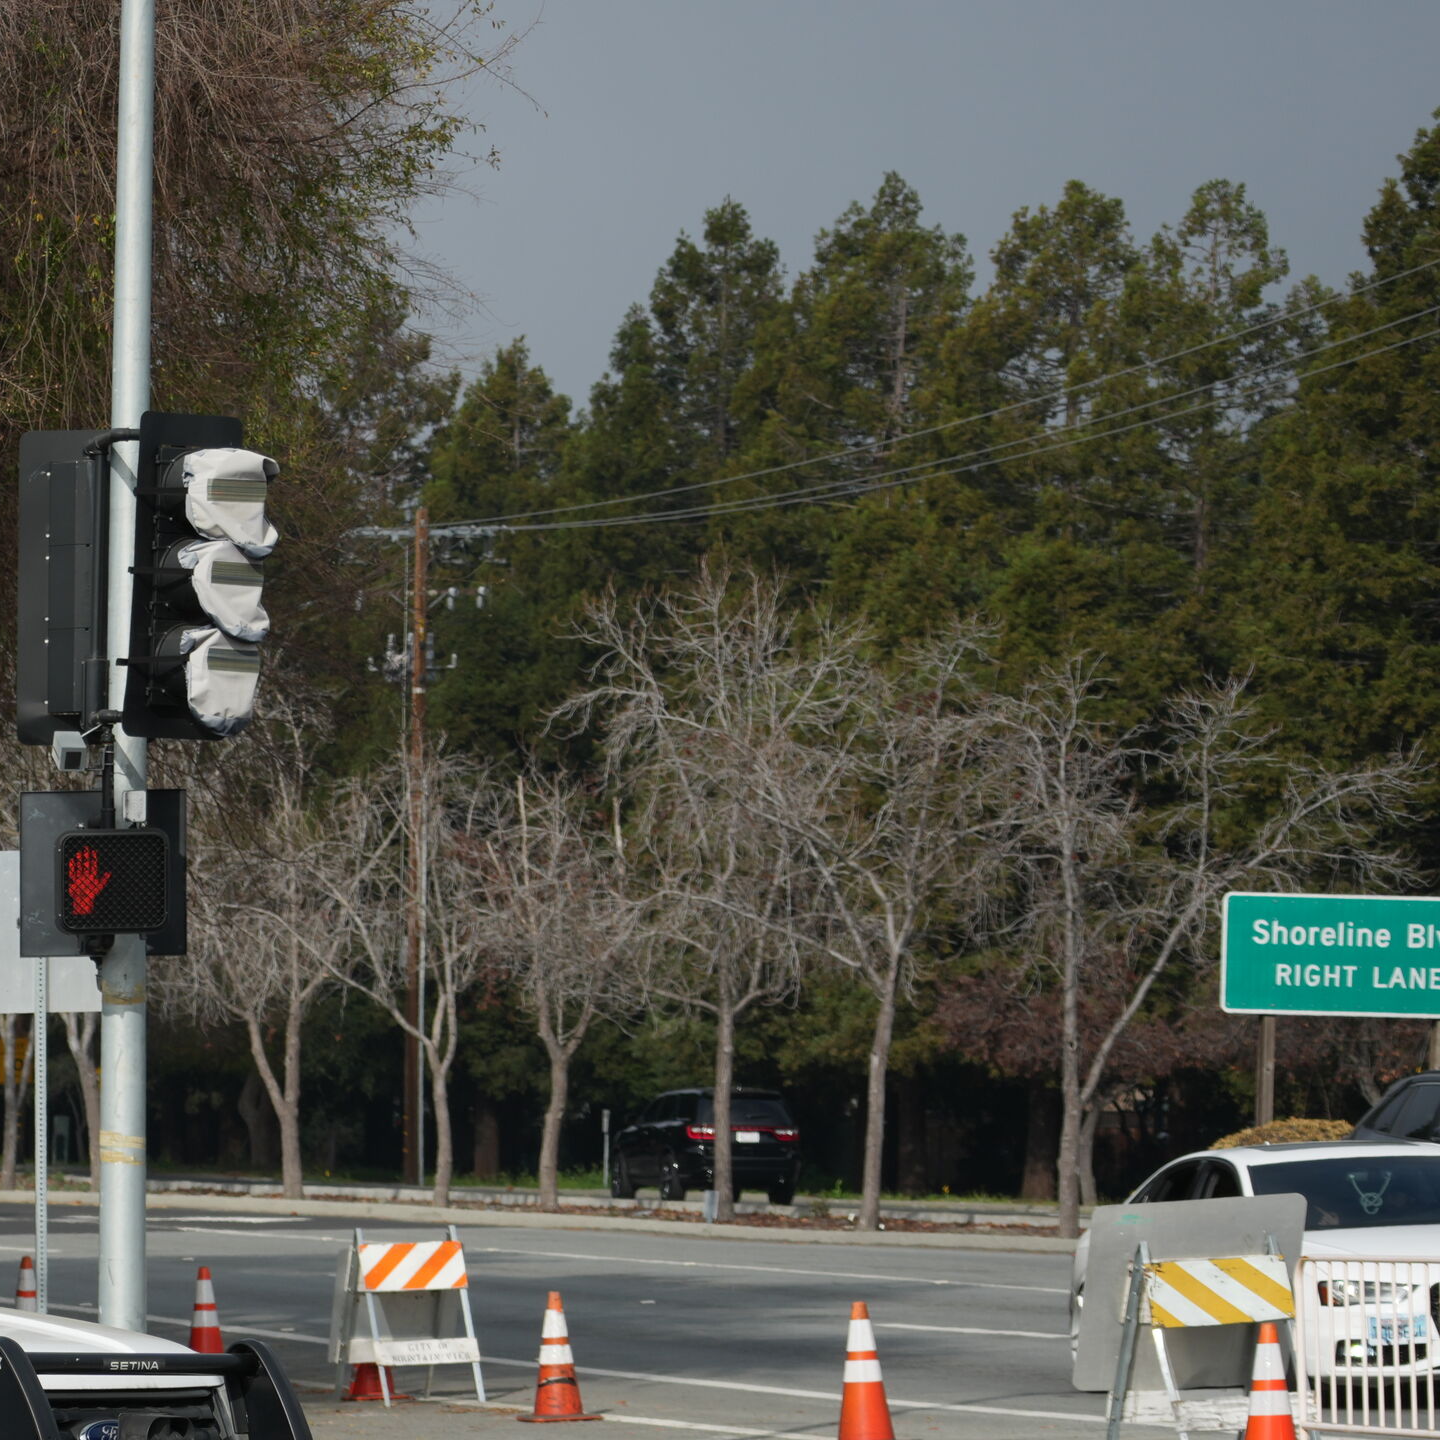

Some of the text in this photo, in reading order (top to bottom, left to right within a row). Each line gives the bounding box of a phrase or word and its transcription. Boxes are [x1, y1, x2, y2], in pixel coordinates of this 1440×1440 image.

[1251, 918, 1440, 950] Shoreline Bl
[1275, 963, 1359, 988] RIGHT
[109, 1360, 160, 1371] SETINA
